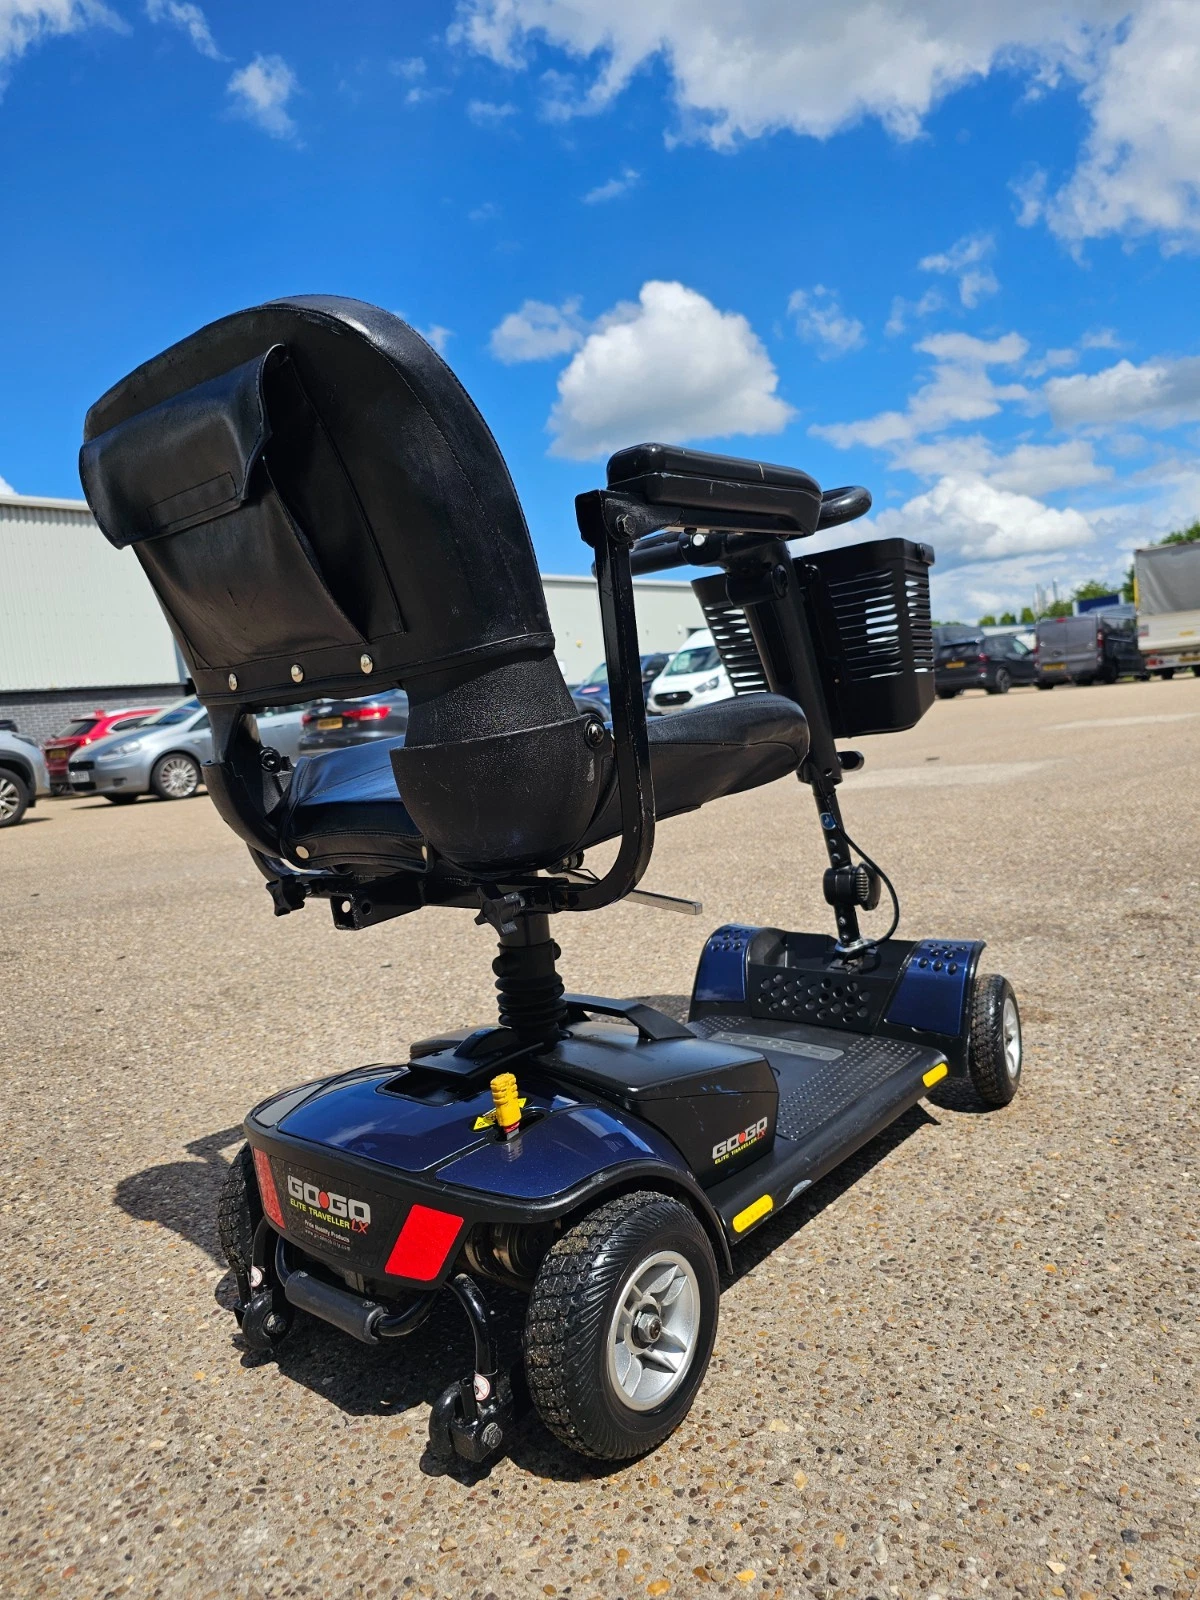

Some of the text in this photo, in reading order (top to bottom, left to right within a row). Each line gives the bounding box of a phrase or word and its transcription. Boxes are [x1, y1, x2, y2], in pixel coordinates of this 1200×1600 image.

[714, 1153, 730, 1165] ELITE
[731, 1137, 758, 1156] TRAVELLER
[290, 1198, 369, 1234] ELITE TRAVELLER LX
